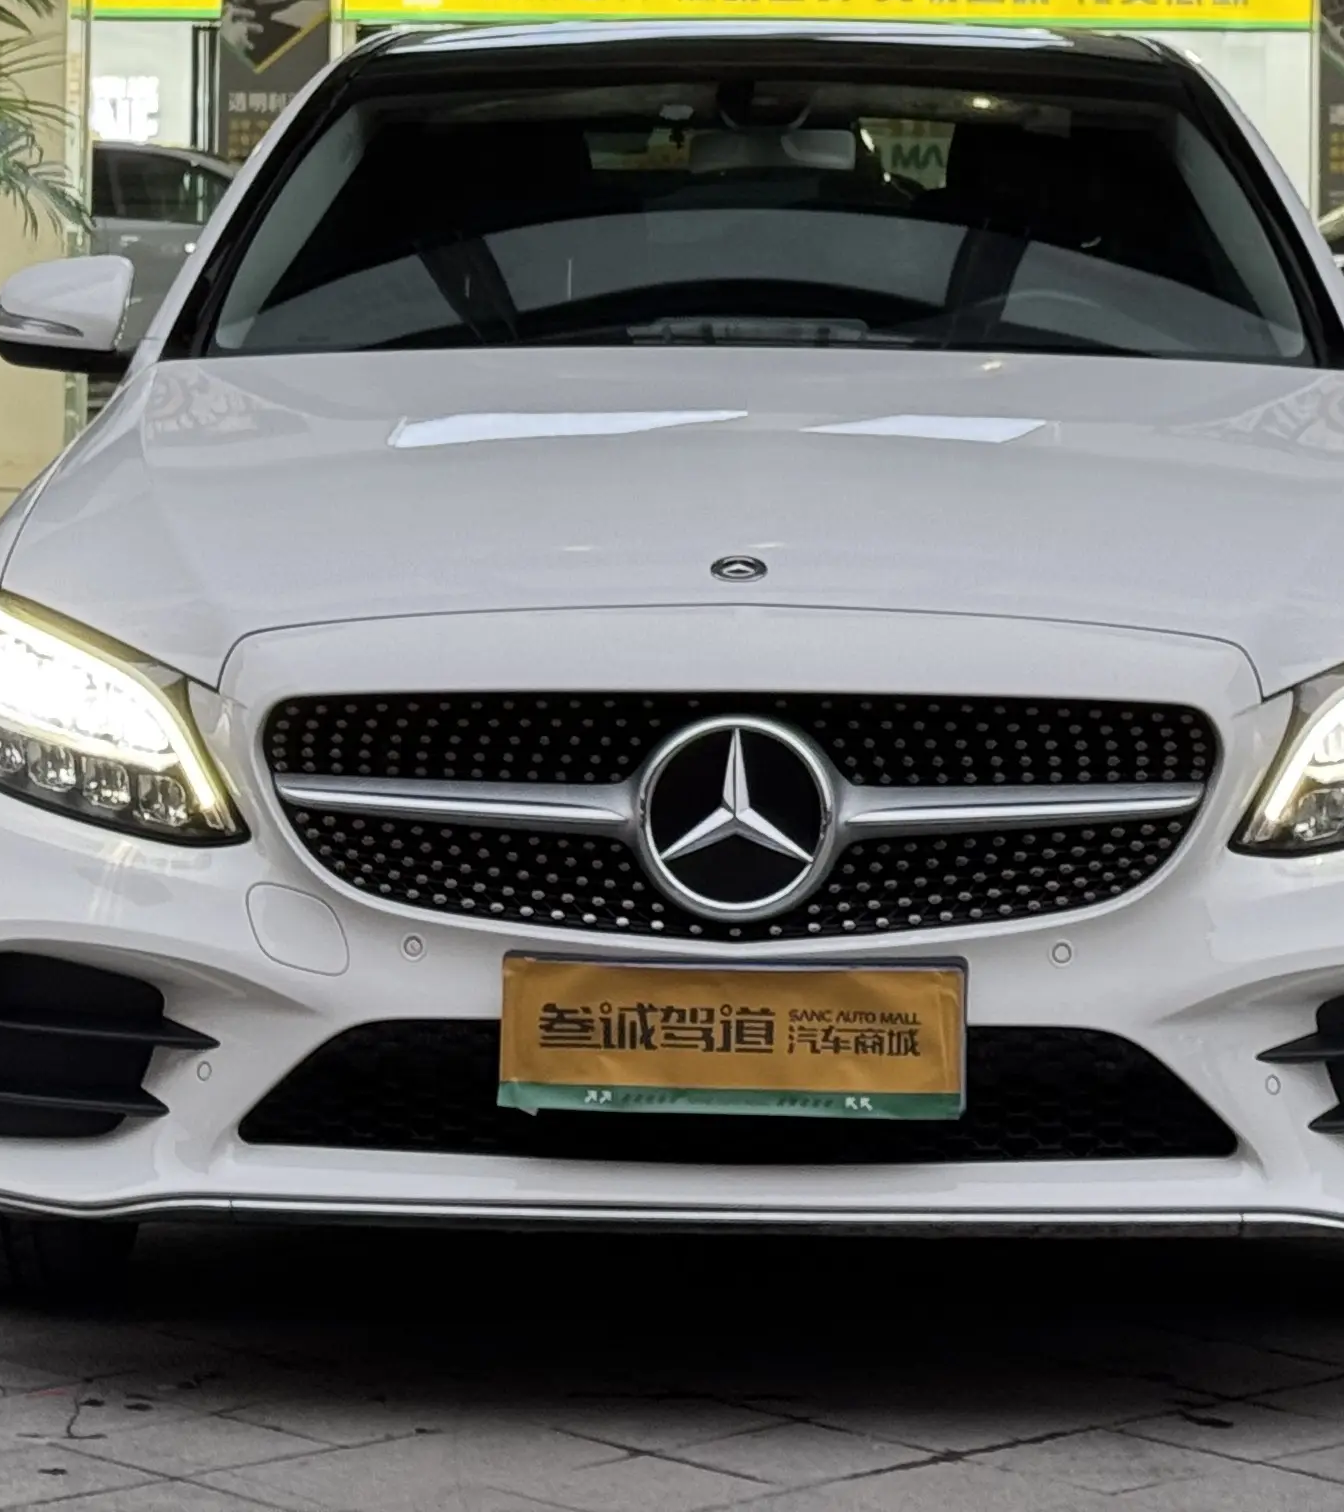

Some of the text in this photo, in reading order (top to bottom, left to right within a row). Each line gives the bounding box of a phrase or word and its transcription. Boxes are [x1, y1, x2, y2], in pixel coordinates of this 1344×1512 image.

[537, 1001, 776, 1054] 叁诚驾道
[788, 1008, 922, 1026] SANC AUTO MALL
[786, 1024, 922, 1057] 汽车商城
